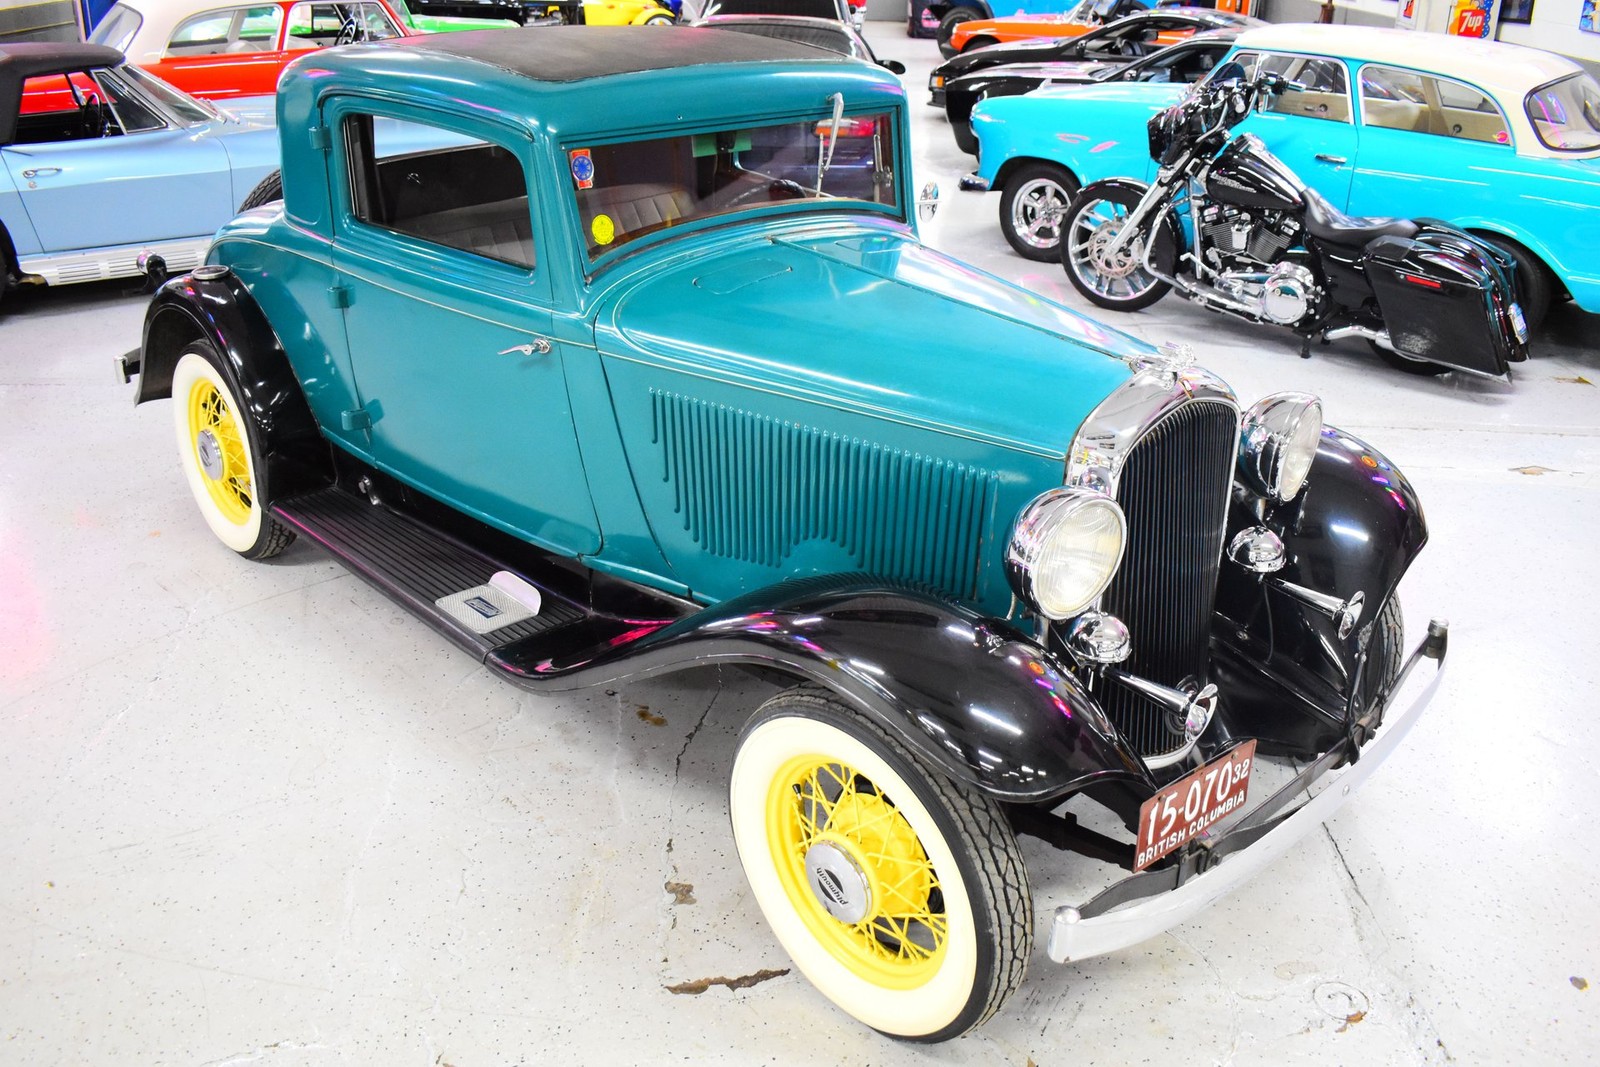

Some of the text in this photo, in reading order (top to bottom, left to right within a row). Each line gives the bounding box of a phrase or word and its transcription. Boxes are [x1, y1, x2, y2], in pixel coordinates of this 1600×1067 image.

[1137, 788, 1245, 868] BRITISH COLUMBIA
[1147, 758, 1251, 846] 15-070 32
